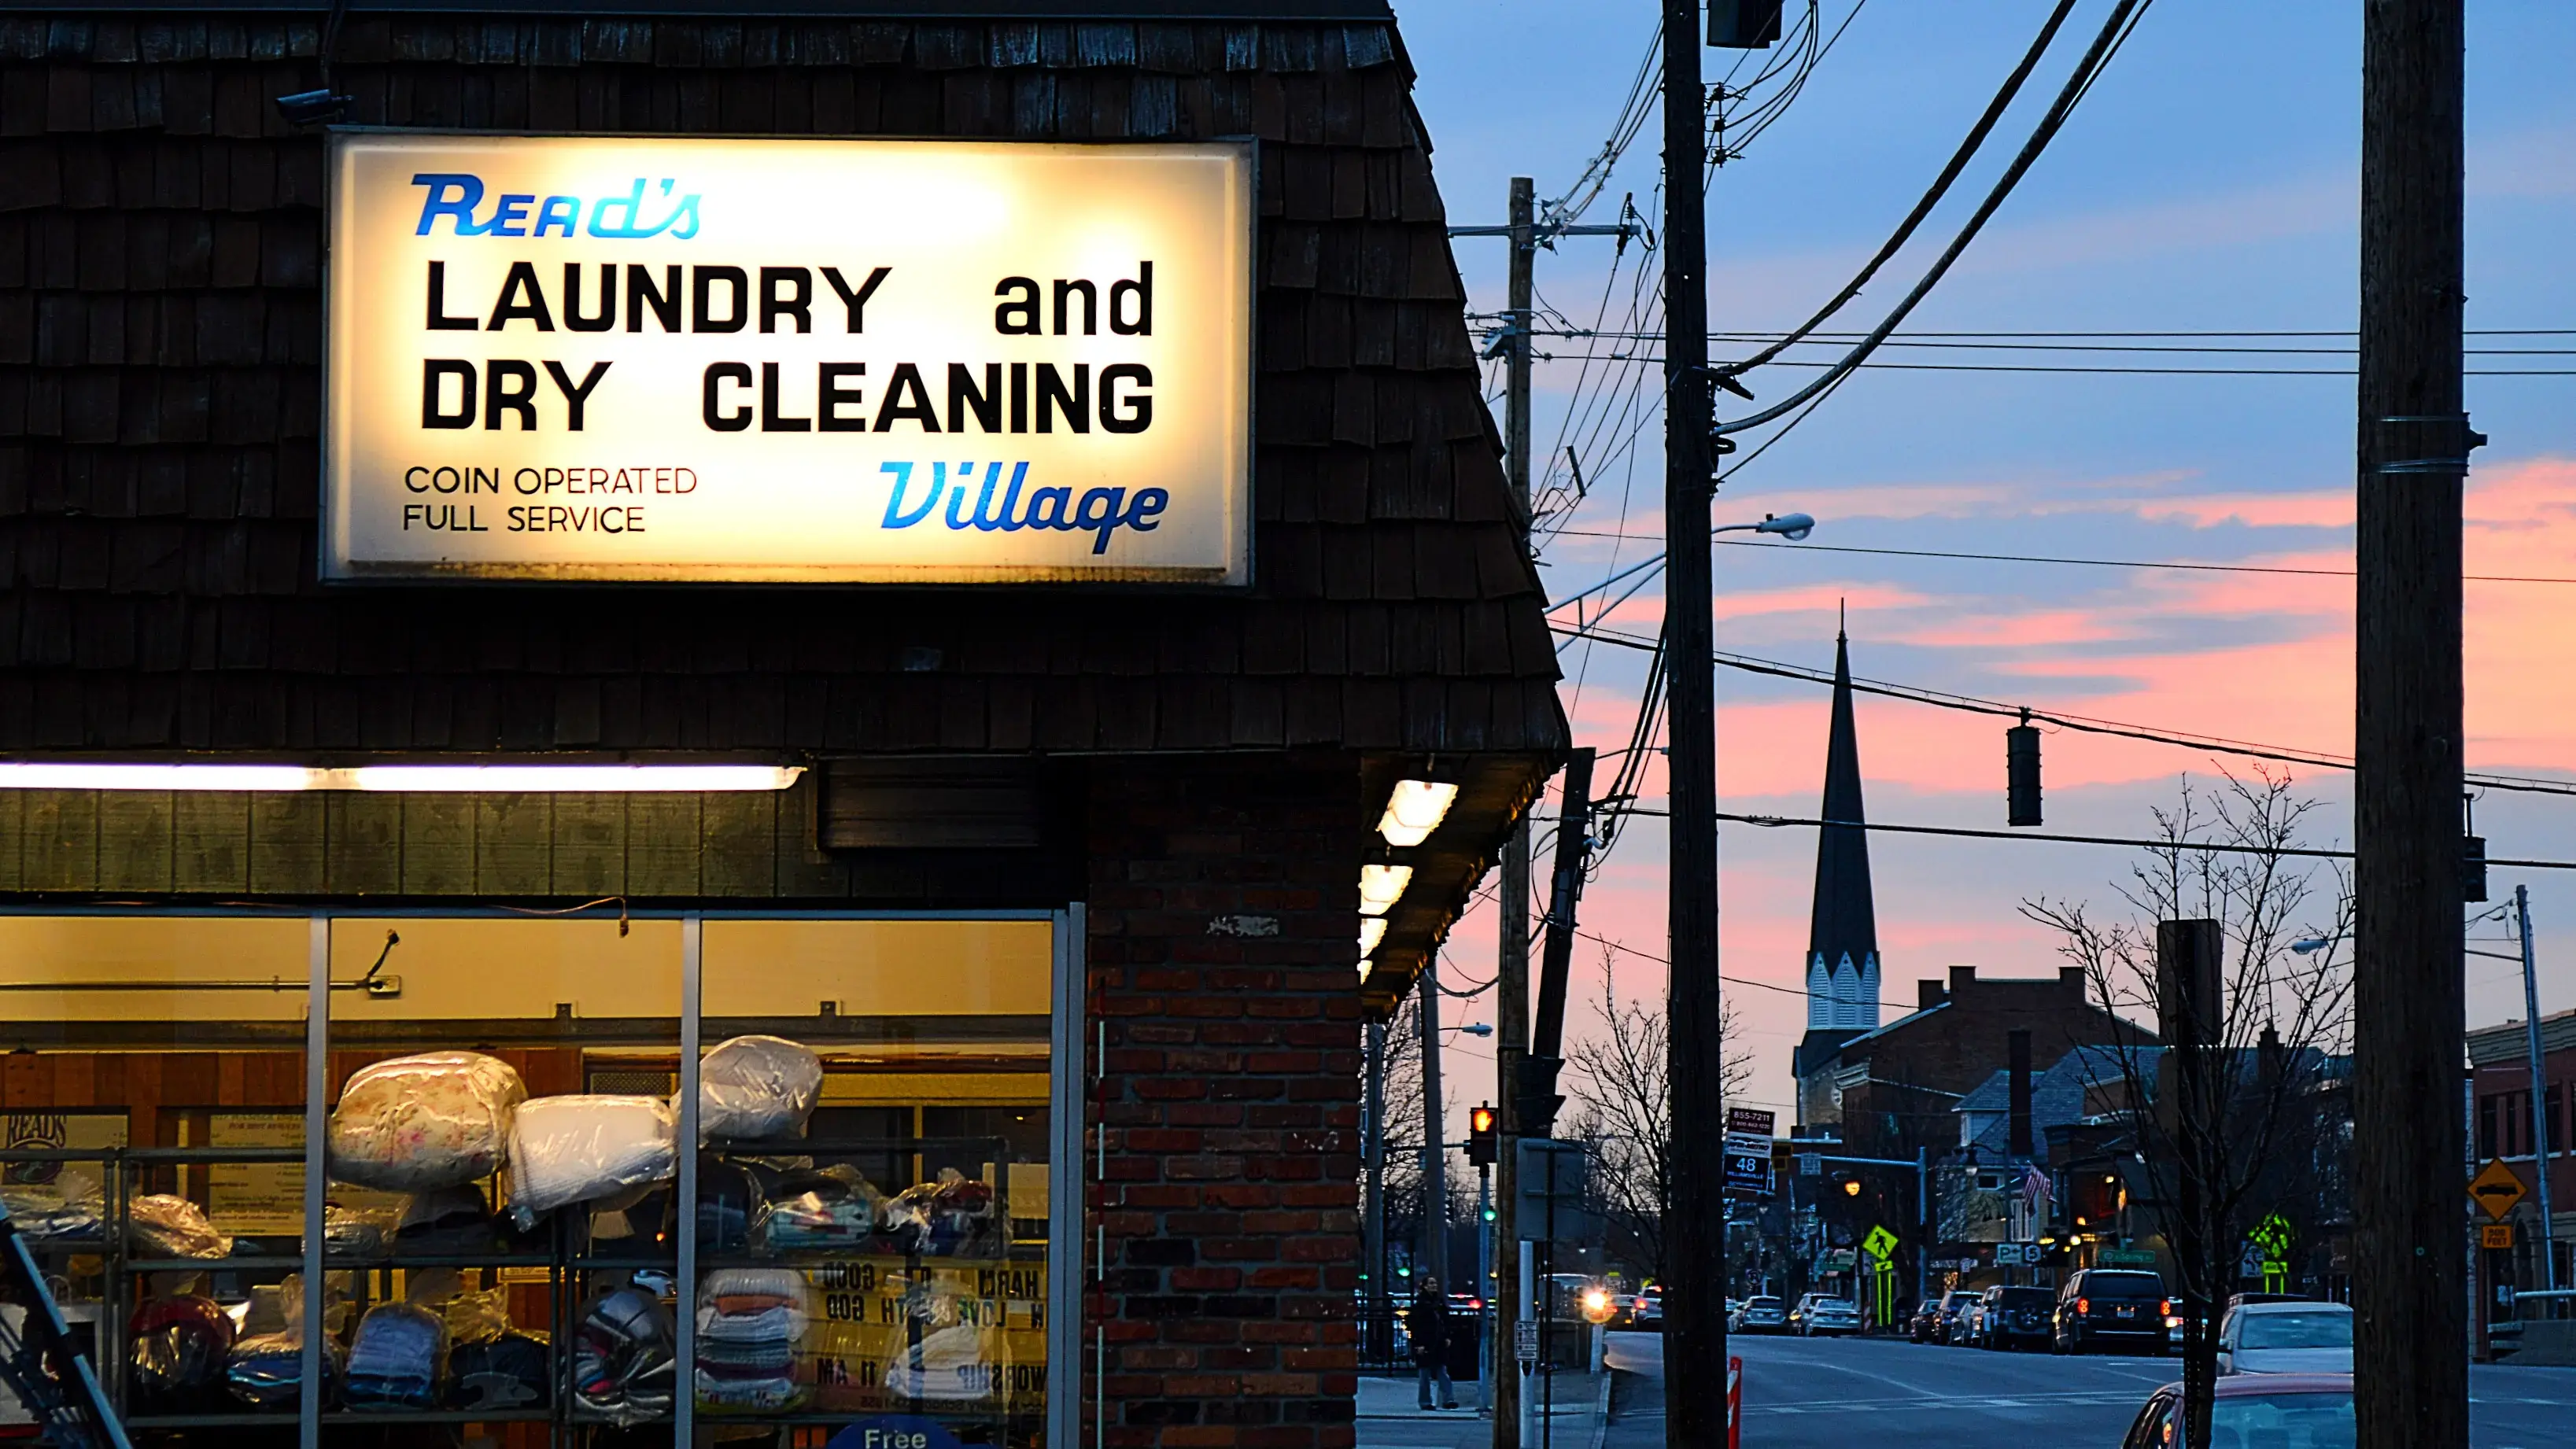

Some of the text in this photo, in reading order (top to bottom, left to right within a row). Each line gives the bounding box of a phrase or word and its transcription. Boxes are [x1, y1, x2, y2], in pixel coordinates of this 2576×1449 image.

[426, 260, 1153, 337] LAUNDRY and
[421, 359, 1153, 435] DRY CLEANING
[403, 466, 697, 496] COIN OPERATED
[403, 504, 645, 534] FULL SERVICE
[877, 460, 1170, 555] Village
[1733, 1111, 1770, 1122] 855-7211
[1736, 1157, 1756, 1172] 48
[1999, 1247, 2011, 1260] P
[864, 1429, 928, 1449] Free
